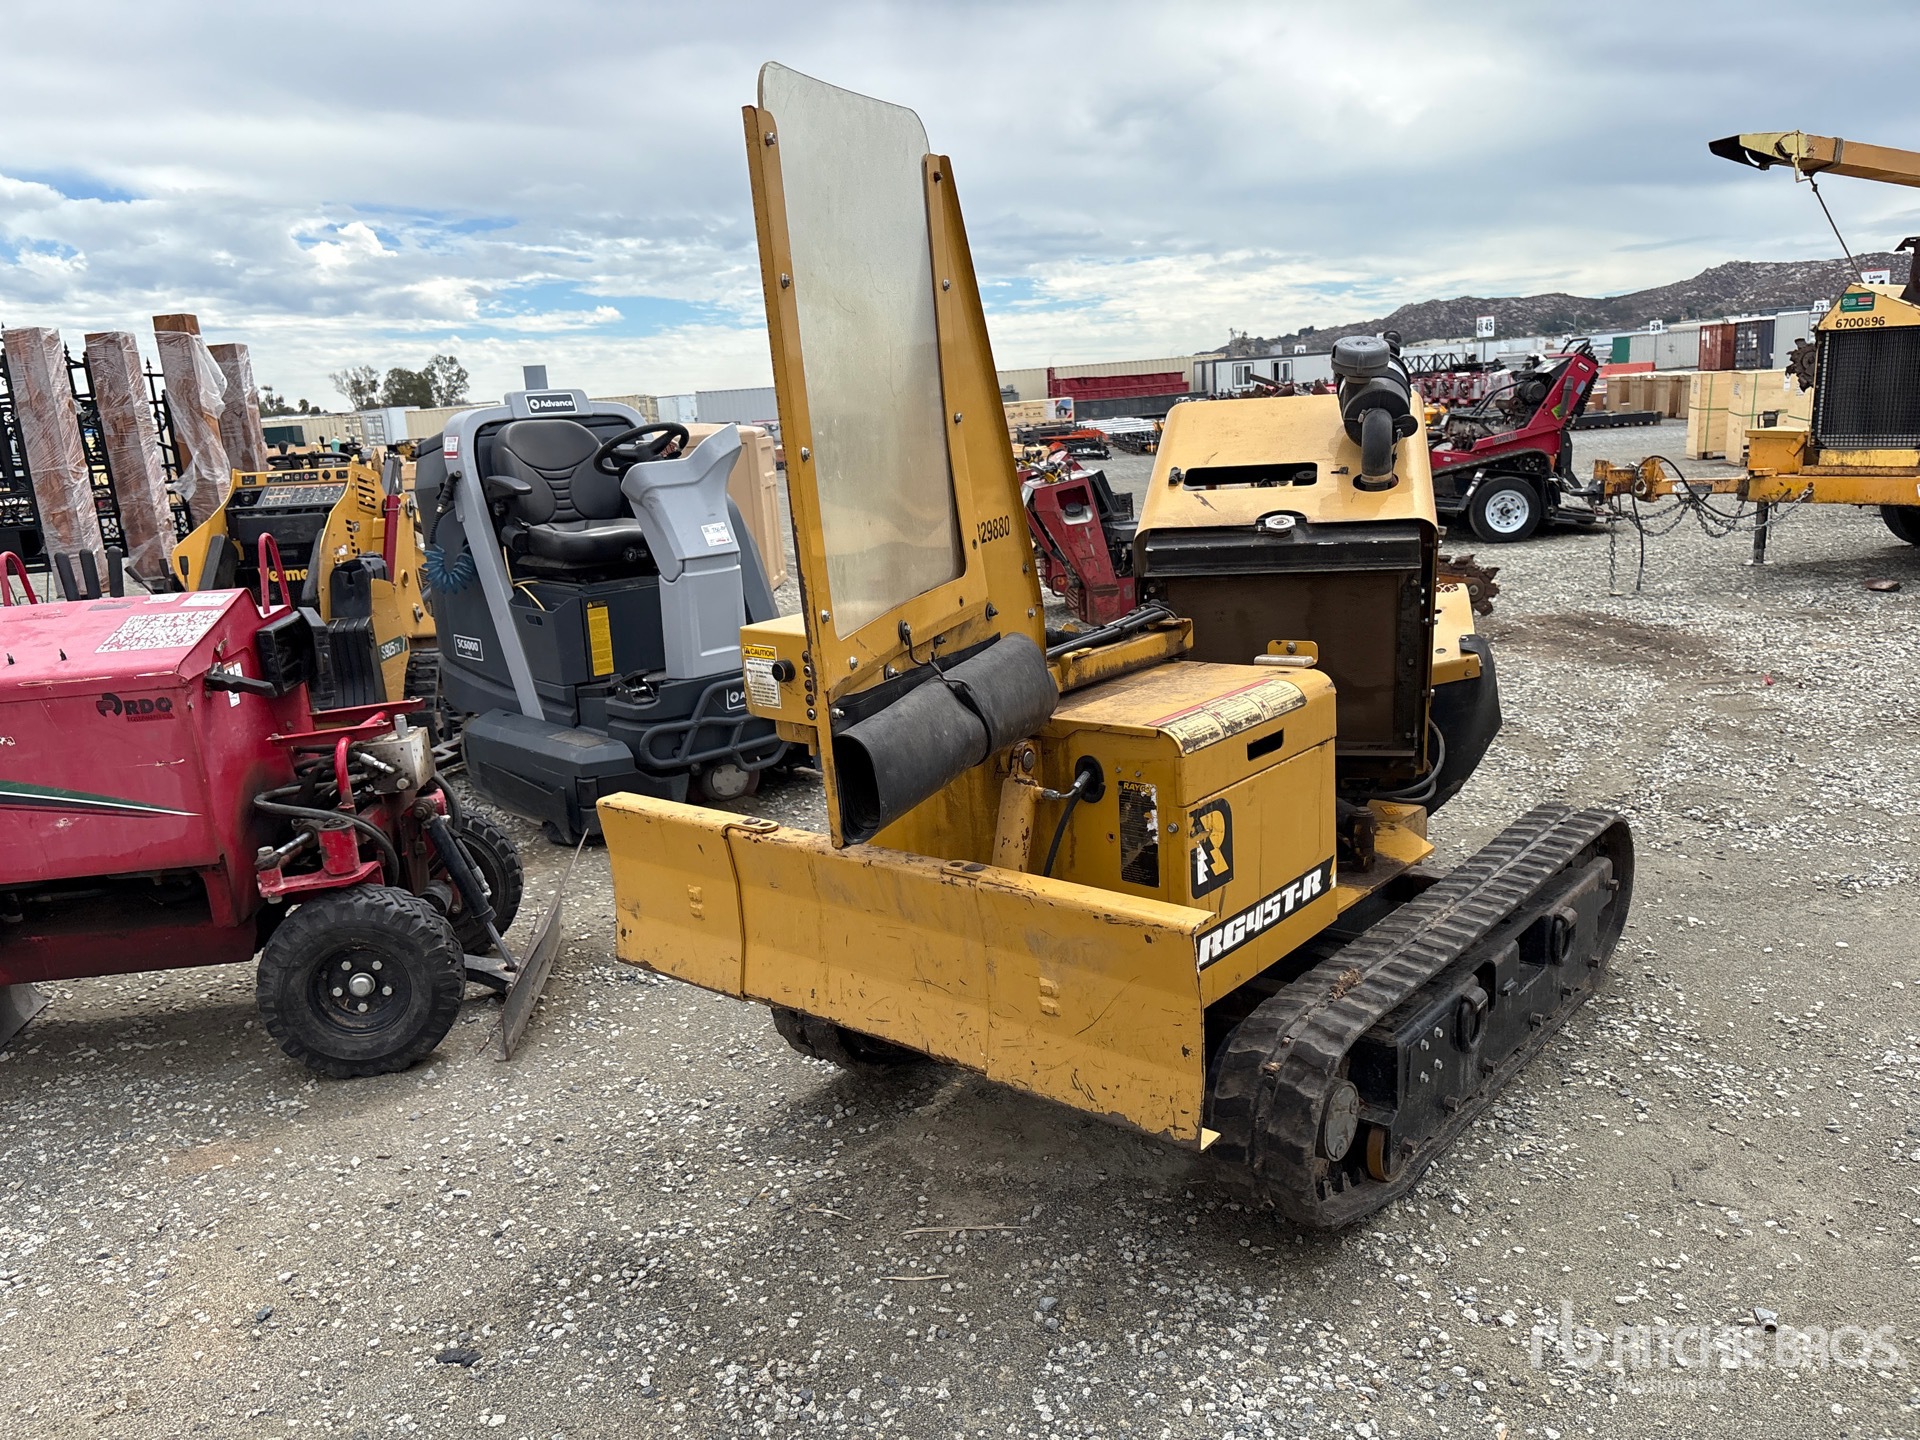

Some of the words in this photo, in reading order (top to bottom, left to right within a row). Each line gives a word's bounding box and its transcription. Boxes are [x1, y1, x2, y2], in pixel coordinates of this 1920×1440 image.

[1836, 317, 1885, 328] 6700896
[541, 400, 573, 408] Advance
[750, 648, 775, 657] CAUTION
